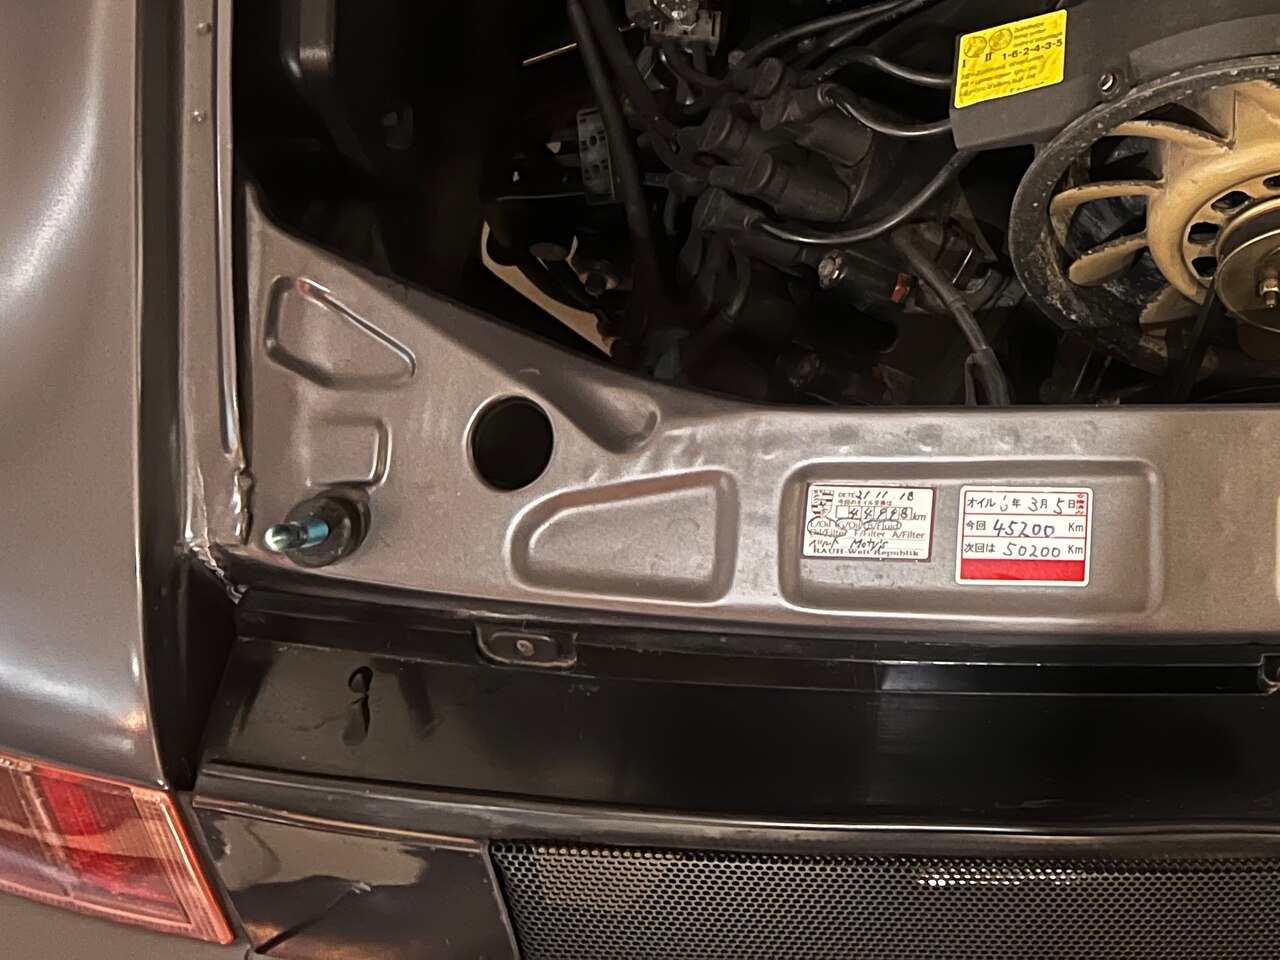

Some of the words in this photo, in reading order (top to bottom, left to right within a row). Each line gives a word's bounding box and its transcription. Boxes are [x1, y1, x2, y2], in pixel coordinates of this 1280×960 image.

[1002, 38, 1063, 61] 1-6-2-4-3-5
[967, 496, 996, 509] オイル
[892, 530, 925, 539] A/Filter
[965, 520, 987, 531] 今回
[993, 519, 1056, 538] 45200
[1068, 522, 1084, 532] Km
[964, 542, 996, 553] 次回は
[1003, 542, 1061, 558] 50200
[1067, 544, 1083, 554] Km
